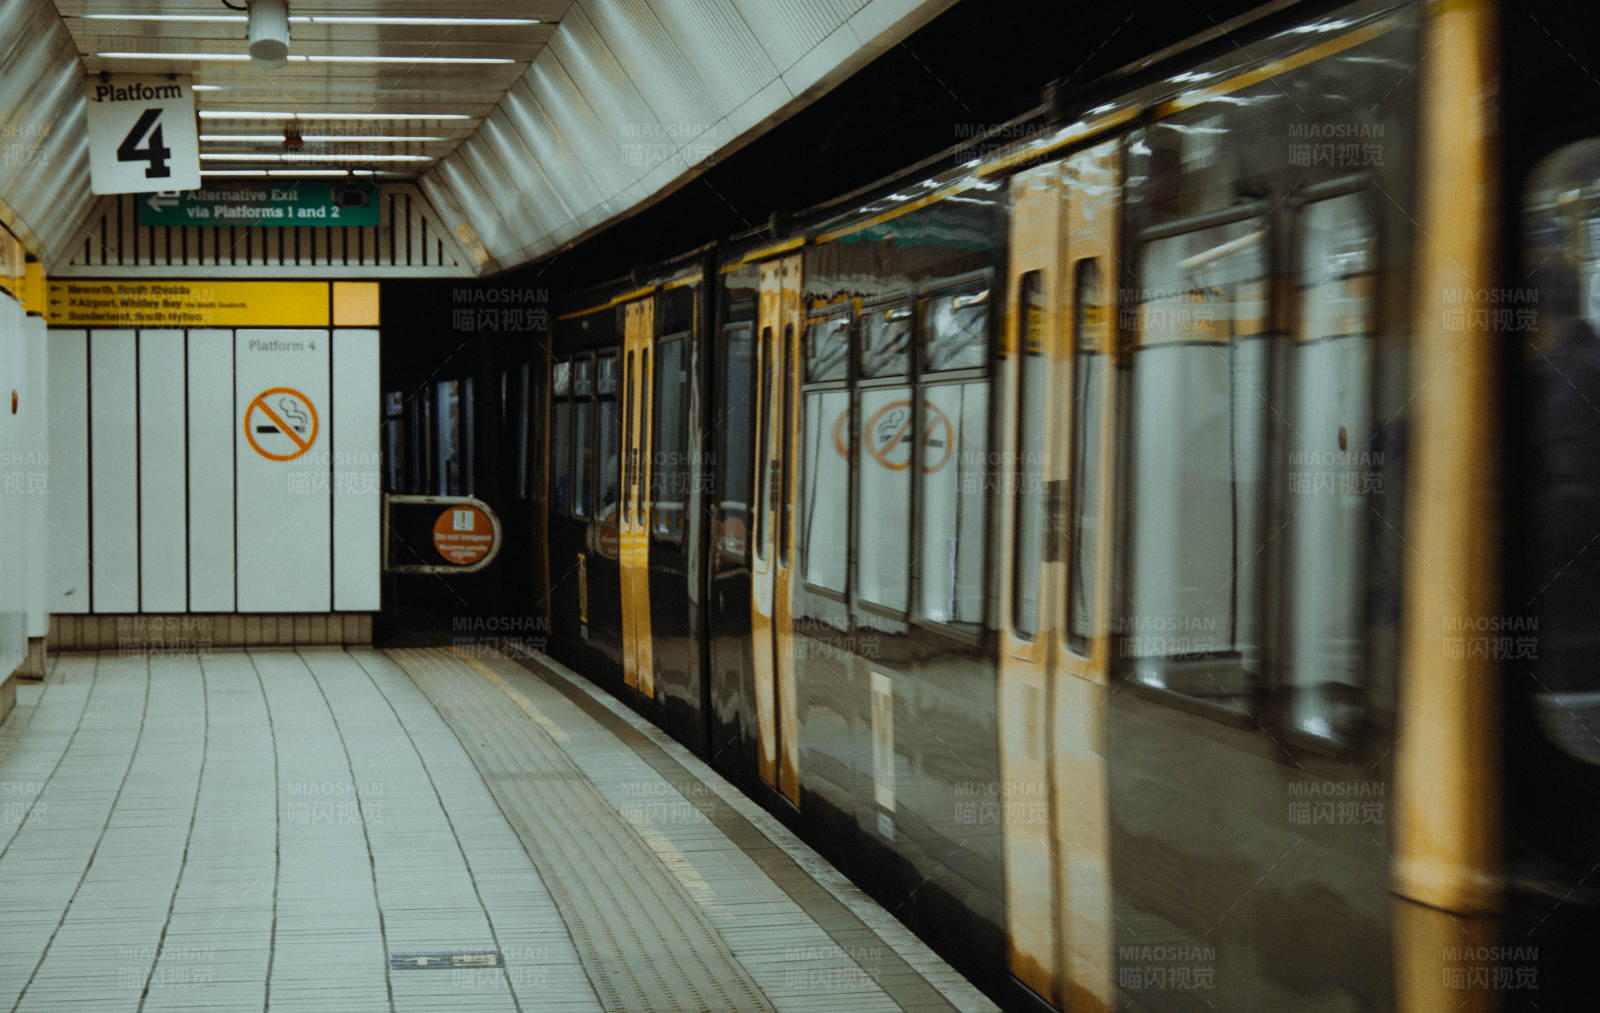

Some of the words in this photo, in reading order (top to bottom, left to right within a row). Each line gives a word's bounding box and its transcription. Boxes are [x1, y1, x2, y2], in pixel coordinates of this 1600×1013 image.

[94, 84, 183, 102] Platform
[117, 107, 171, 178] 4
[186, 188, 267, 201] Alternative
[271, 188, 299, 201] Exit
[187, 207, 210, 218] via
[213, 206, 283, 218] Platforms
[298, 206, 326, 218] and
[330, 207, 340, 218] 2
[249, 340, 305, 352] Platform
[308, 341, 316, 352] 4
